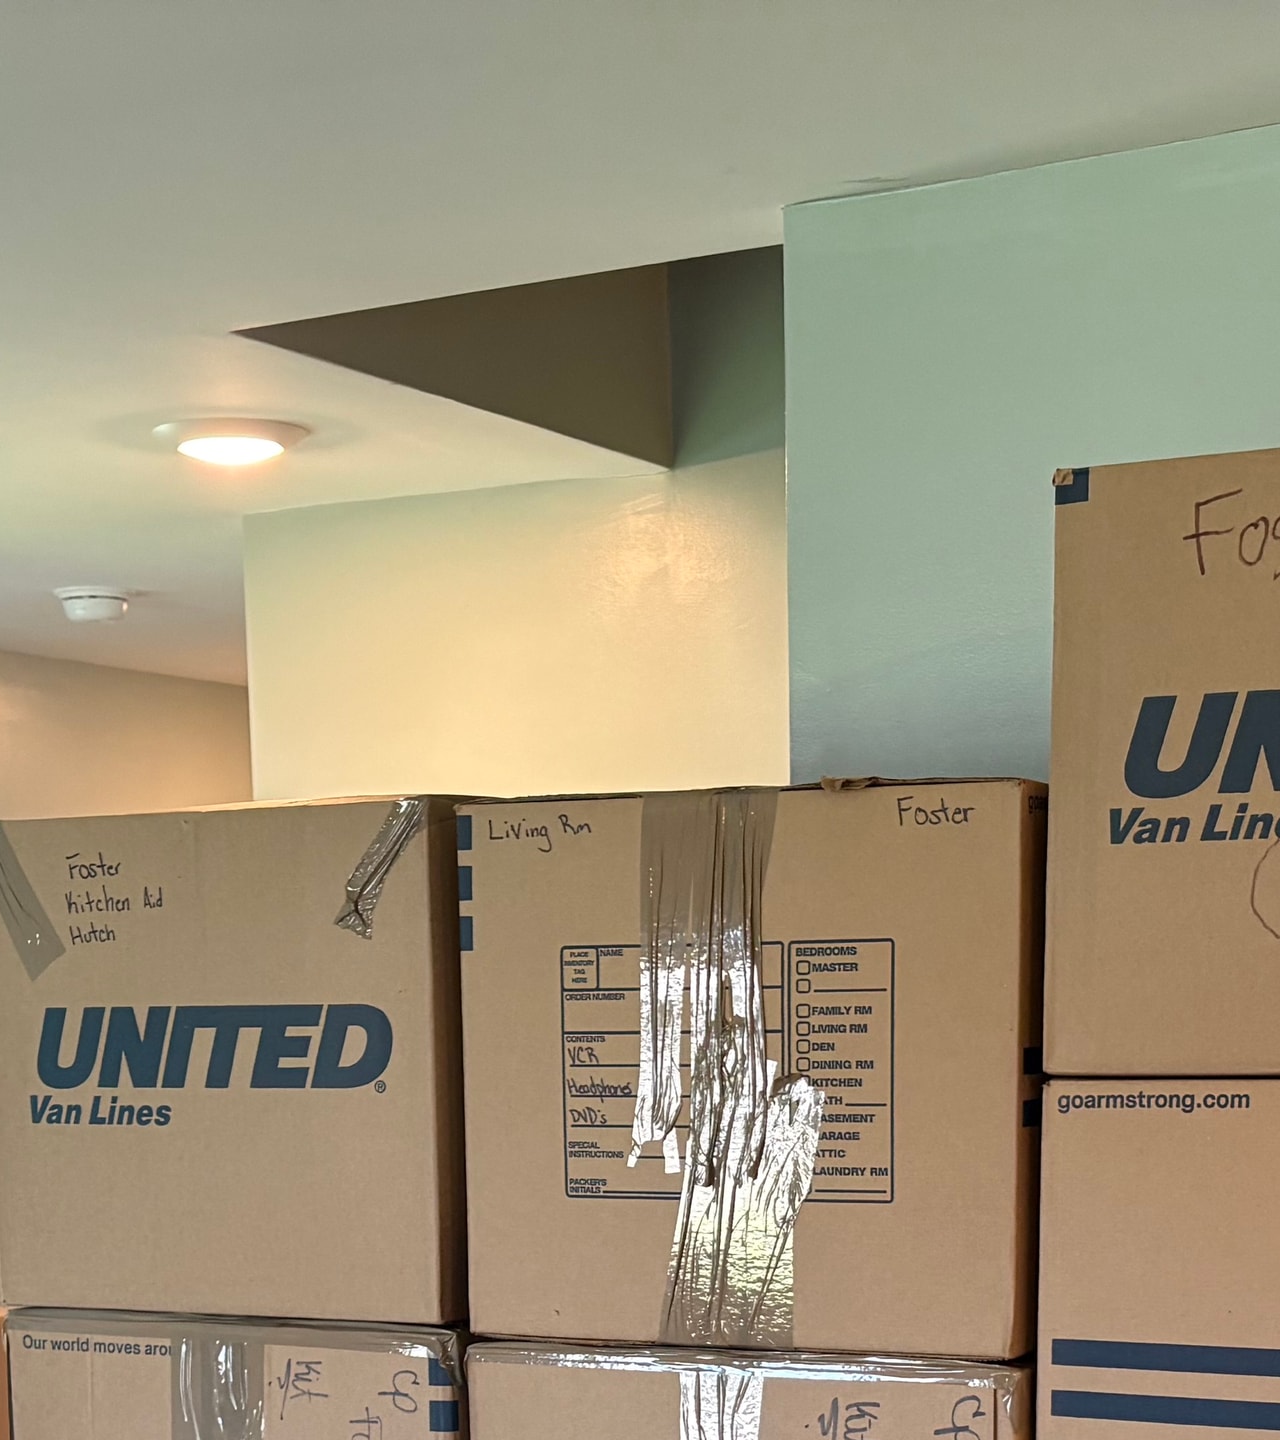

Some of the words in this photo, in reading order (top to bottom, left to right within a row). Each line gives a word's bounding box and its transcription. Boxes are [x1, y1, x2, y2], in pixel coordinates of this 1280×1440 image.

[896, 796, 976, 827] Foster
[1108, 806, 1190, 845] Van
[488, 819, 552, 853] Living
[65, 852, 122, 880] Foster
[65, 885, 131, 915] Kitchen
[69, 925, 117, 946] Hutch
[599, 948, 624, 957] NAME
[795, 946, 858, 957] BEDROOMS
[811, 962, 859, 973] MASTER
[565, 993, 591, 1001] ORDER
[592, 992, 625, 1001] NUMBER
[811, 1006, 853, 1016] FAMILY
[854, 1005, 873, 1015] RM
[811, 1024, 847, 1034] LIVING
[849, 1023, 868, 1034] RM
[565, 1035, 606, 1043] CONTENTS
[36, 1003, 394, 1090] UNITED
[811, 1042, 836, 1052] DEN
[567, 1046, 600, 1065] VCR
[811, 1060, 852, 1070] DINING
[855, 1060, 875, 1070] RM
[811, 1078, 863, 1088] KITCHEN
[821, 1096, 843, 1106] ATH
[1056, 1087, 1251, 1113] goarmstrong.com
[30, 1094, 82, 1125] Van
[88, 1096, 173, 1127] Lines
[820, 1113, 876, 1124] ASEMENT
[818, 1131, 861, 1141] ARAGE
[568, 1141, 601, 1149] SPECIAL
[568, 1150, 625, 1159] INSTRUCTIONS
[812, 1166, 867, 1177] LAUNDRY
[870, 1167, 889, 1177] RM
[22, 1334, 47, 1350] Our
[50, 1336, 89, 1353] world
[93, 1341, 141, 1356] moves
[144, 1343, 172, 1357] aro
